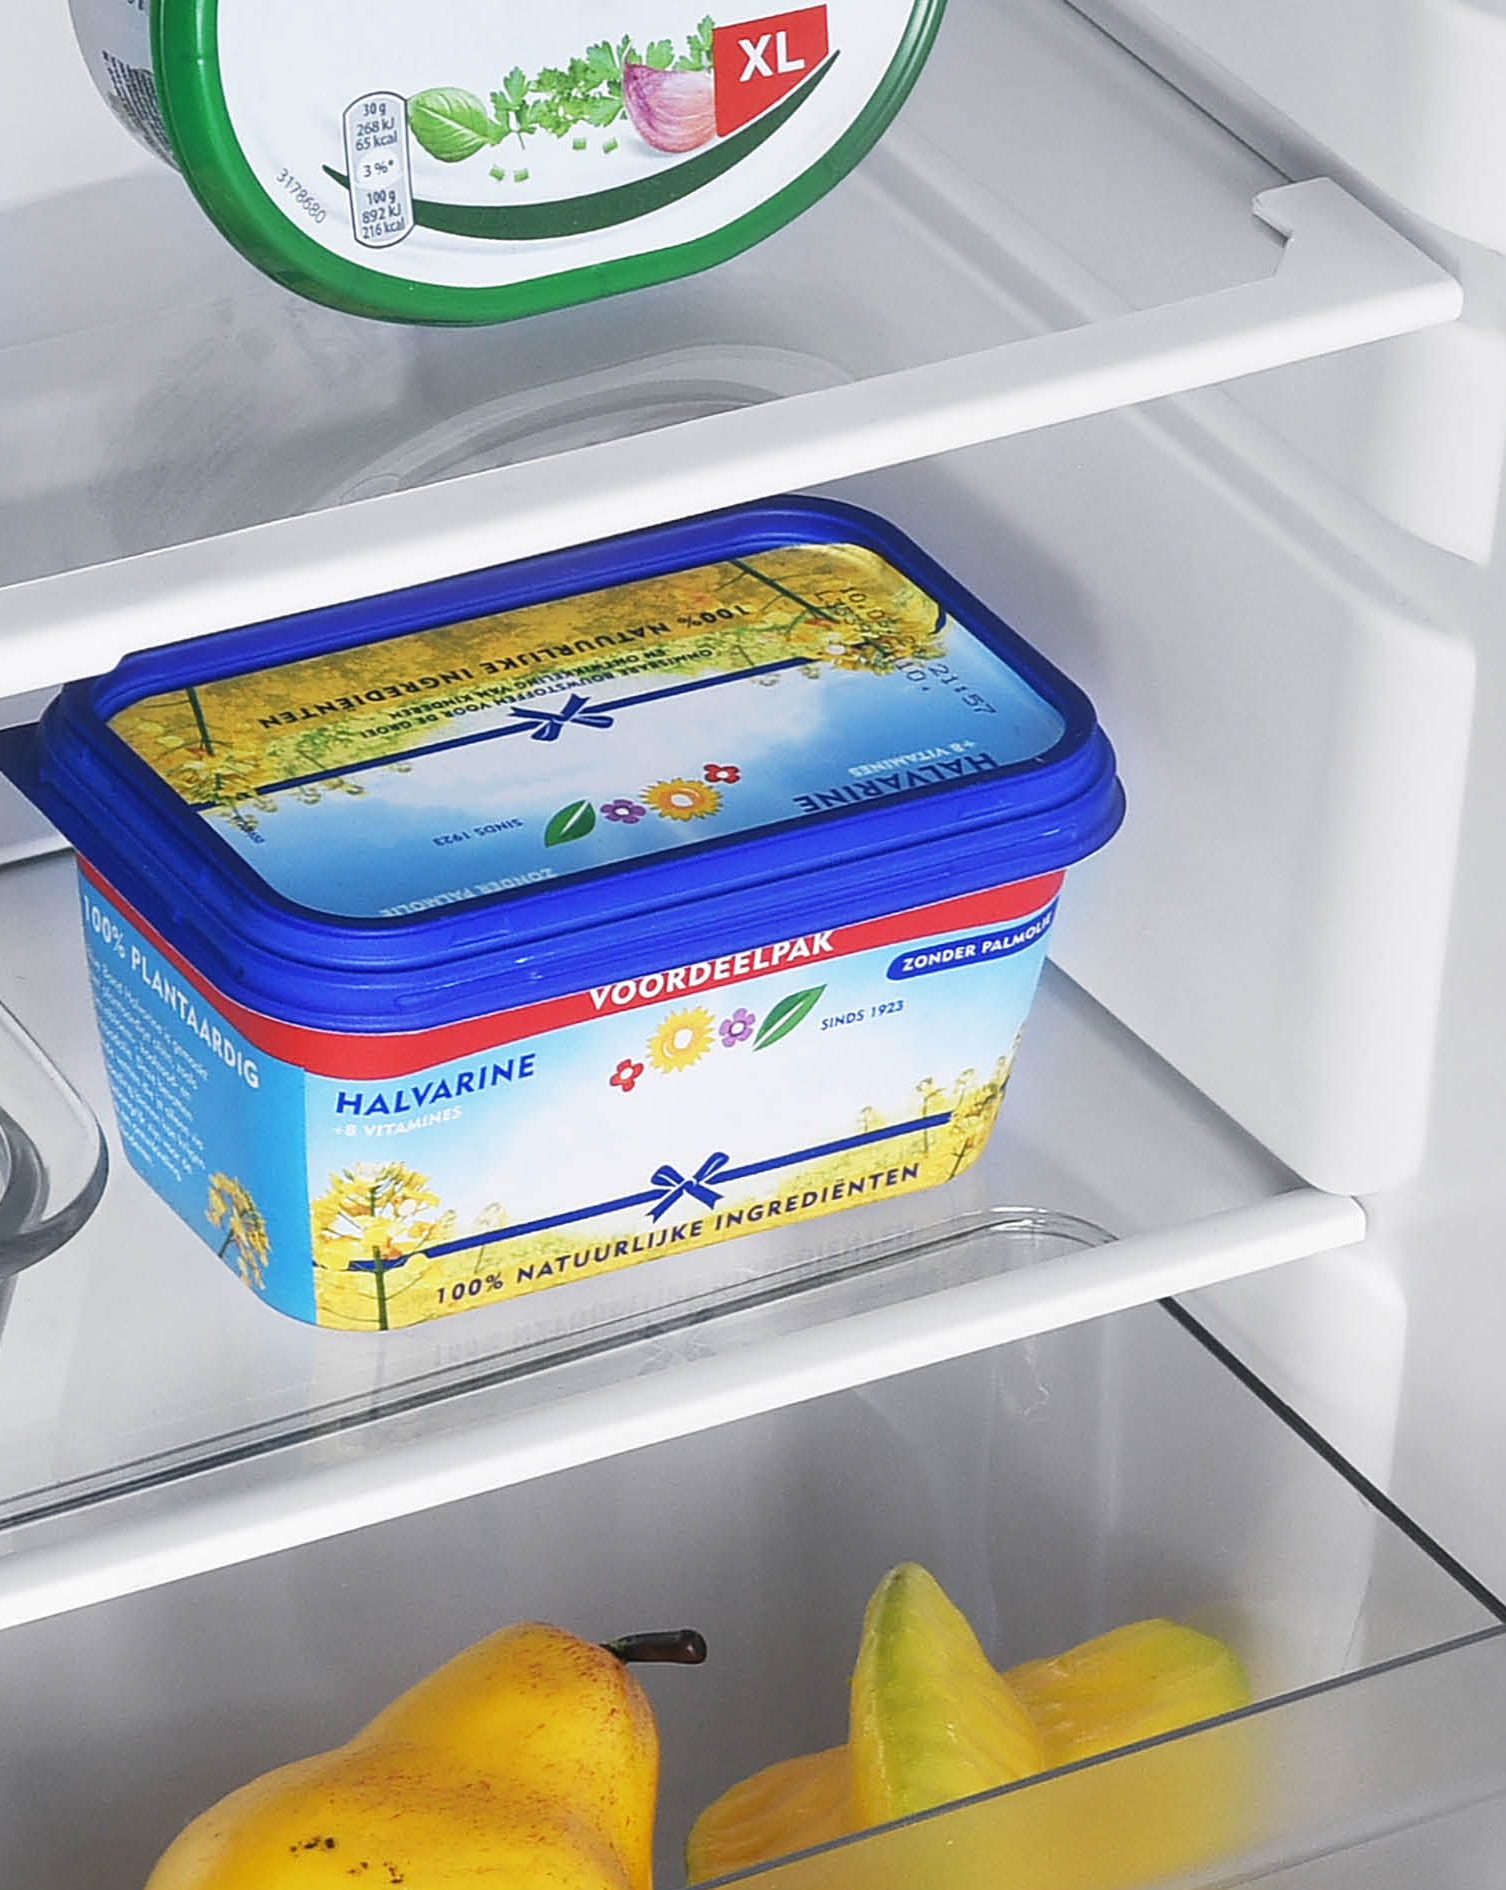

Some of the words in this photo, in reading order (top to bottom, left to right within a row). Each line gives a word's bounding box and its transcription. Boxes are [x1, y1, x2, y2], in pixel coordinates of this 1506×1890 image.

[738, 31, 805, 82] XL
[363, 103, 376, 116] 30
[379, 103, 386, 116] g
[356, 121, 379, 137] 268
[382, 117, 395, 130] kJ
[356, 138, 371, 151] 65
[373, 131, 398, 147] kcal
[363, 165, 371, 178] 3
[276, 168, 327, 224] 3178680
[367, 190, 386, 205] 100
[388, 190, 396, 204] g
[362, 208, 385, 224] 892
[388, 204, 401, 217] kJ
[362, 225, 383, 240] 216
[384, 218, 405, 233] kcal
[677, 603, 751, 630] 100%
[481, 619, 672, 676] NATUURLIJKE
[928, 662, 998, 714] 21:57
[417, 712, 439, 726] DE
[444, 699, 492, 720] VOOR
[360, 721, 408, 739] GROEI
[848, 746, 951, 778] VITAMINES
[793, 753, 998, 813] HALVARINE
[432, 830, 471, 848] 1923
[477, 817, 524, 838] SINDS
[478, 867, 559, 895] ZONDER
[589, 930, 835, 1011] VOORDEELPAK
[902, 944, 977, 972] ZONDER
[82, 894, 127, 960] 100%
[130, 944, 260, 1089] PLANTAARDIG
[820, 1009, 865, 1031] SINDS
[871, 999, 905, 1018] 1923
[335, 1053, 536, 1116] HALVARINE
[362, 1104, 464, 1137] VITAMINES
[437, 1272, 505, 1305] 100%
[515, 1219, 704, 1285] NATUURLIJKE
[713, 1162, 922, 1232] INGREDIËNTEN
